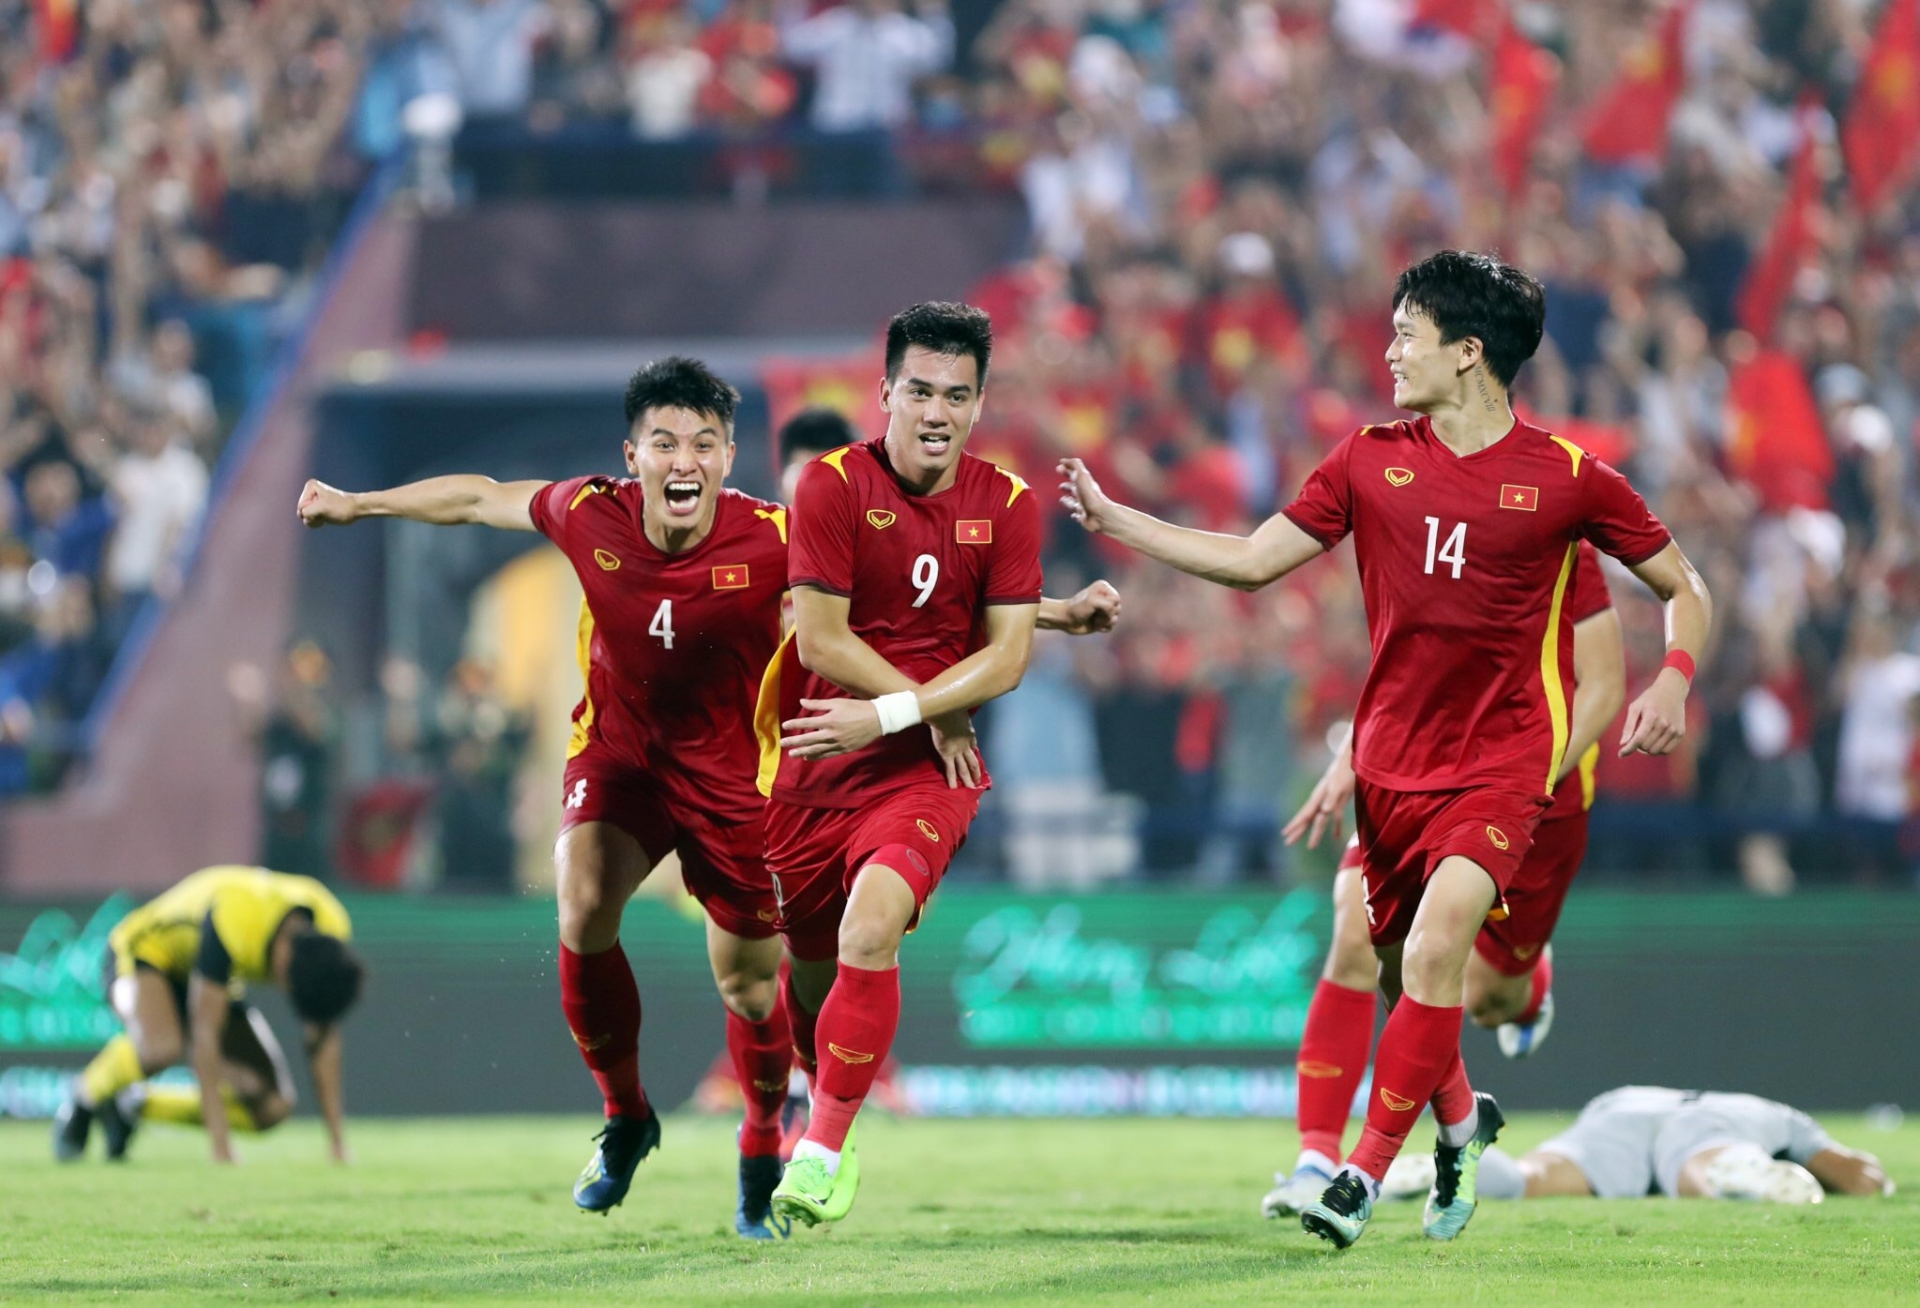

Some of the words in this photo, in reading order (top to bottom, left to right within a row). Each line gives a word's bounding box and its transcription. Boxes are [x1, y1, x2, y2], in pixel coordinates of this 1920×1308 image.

[1424, 515, 1467, 579] 14
[912, 553, 939, 608] 9
[648, 598, 676, 649] 4
